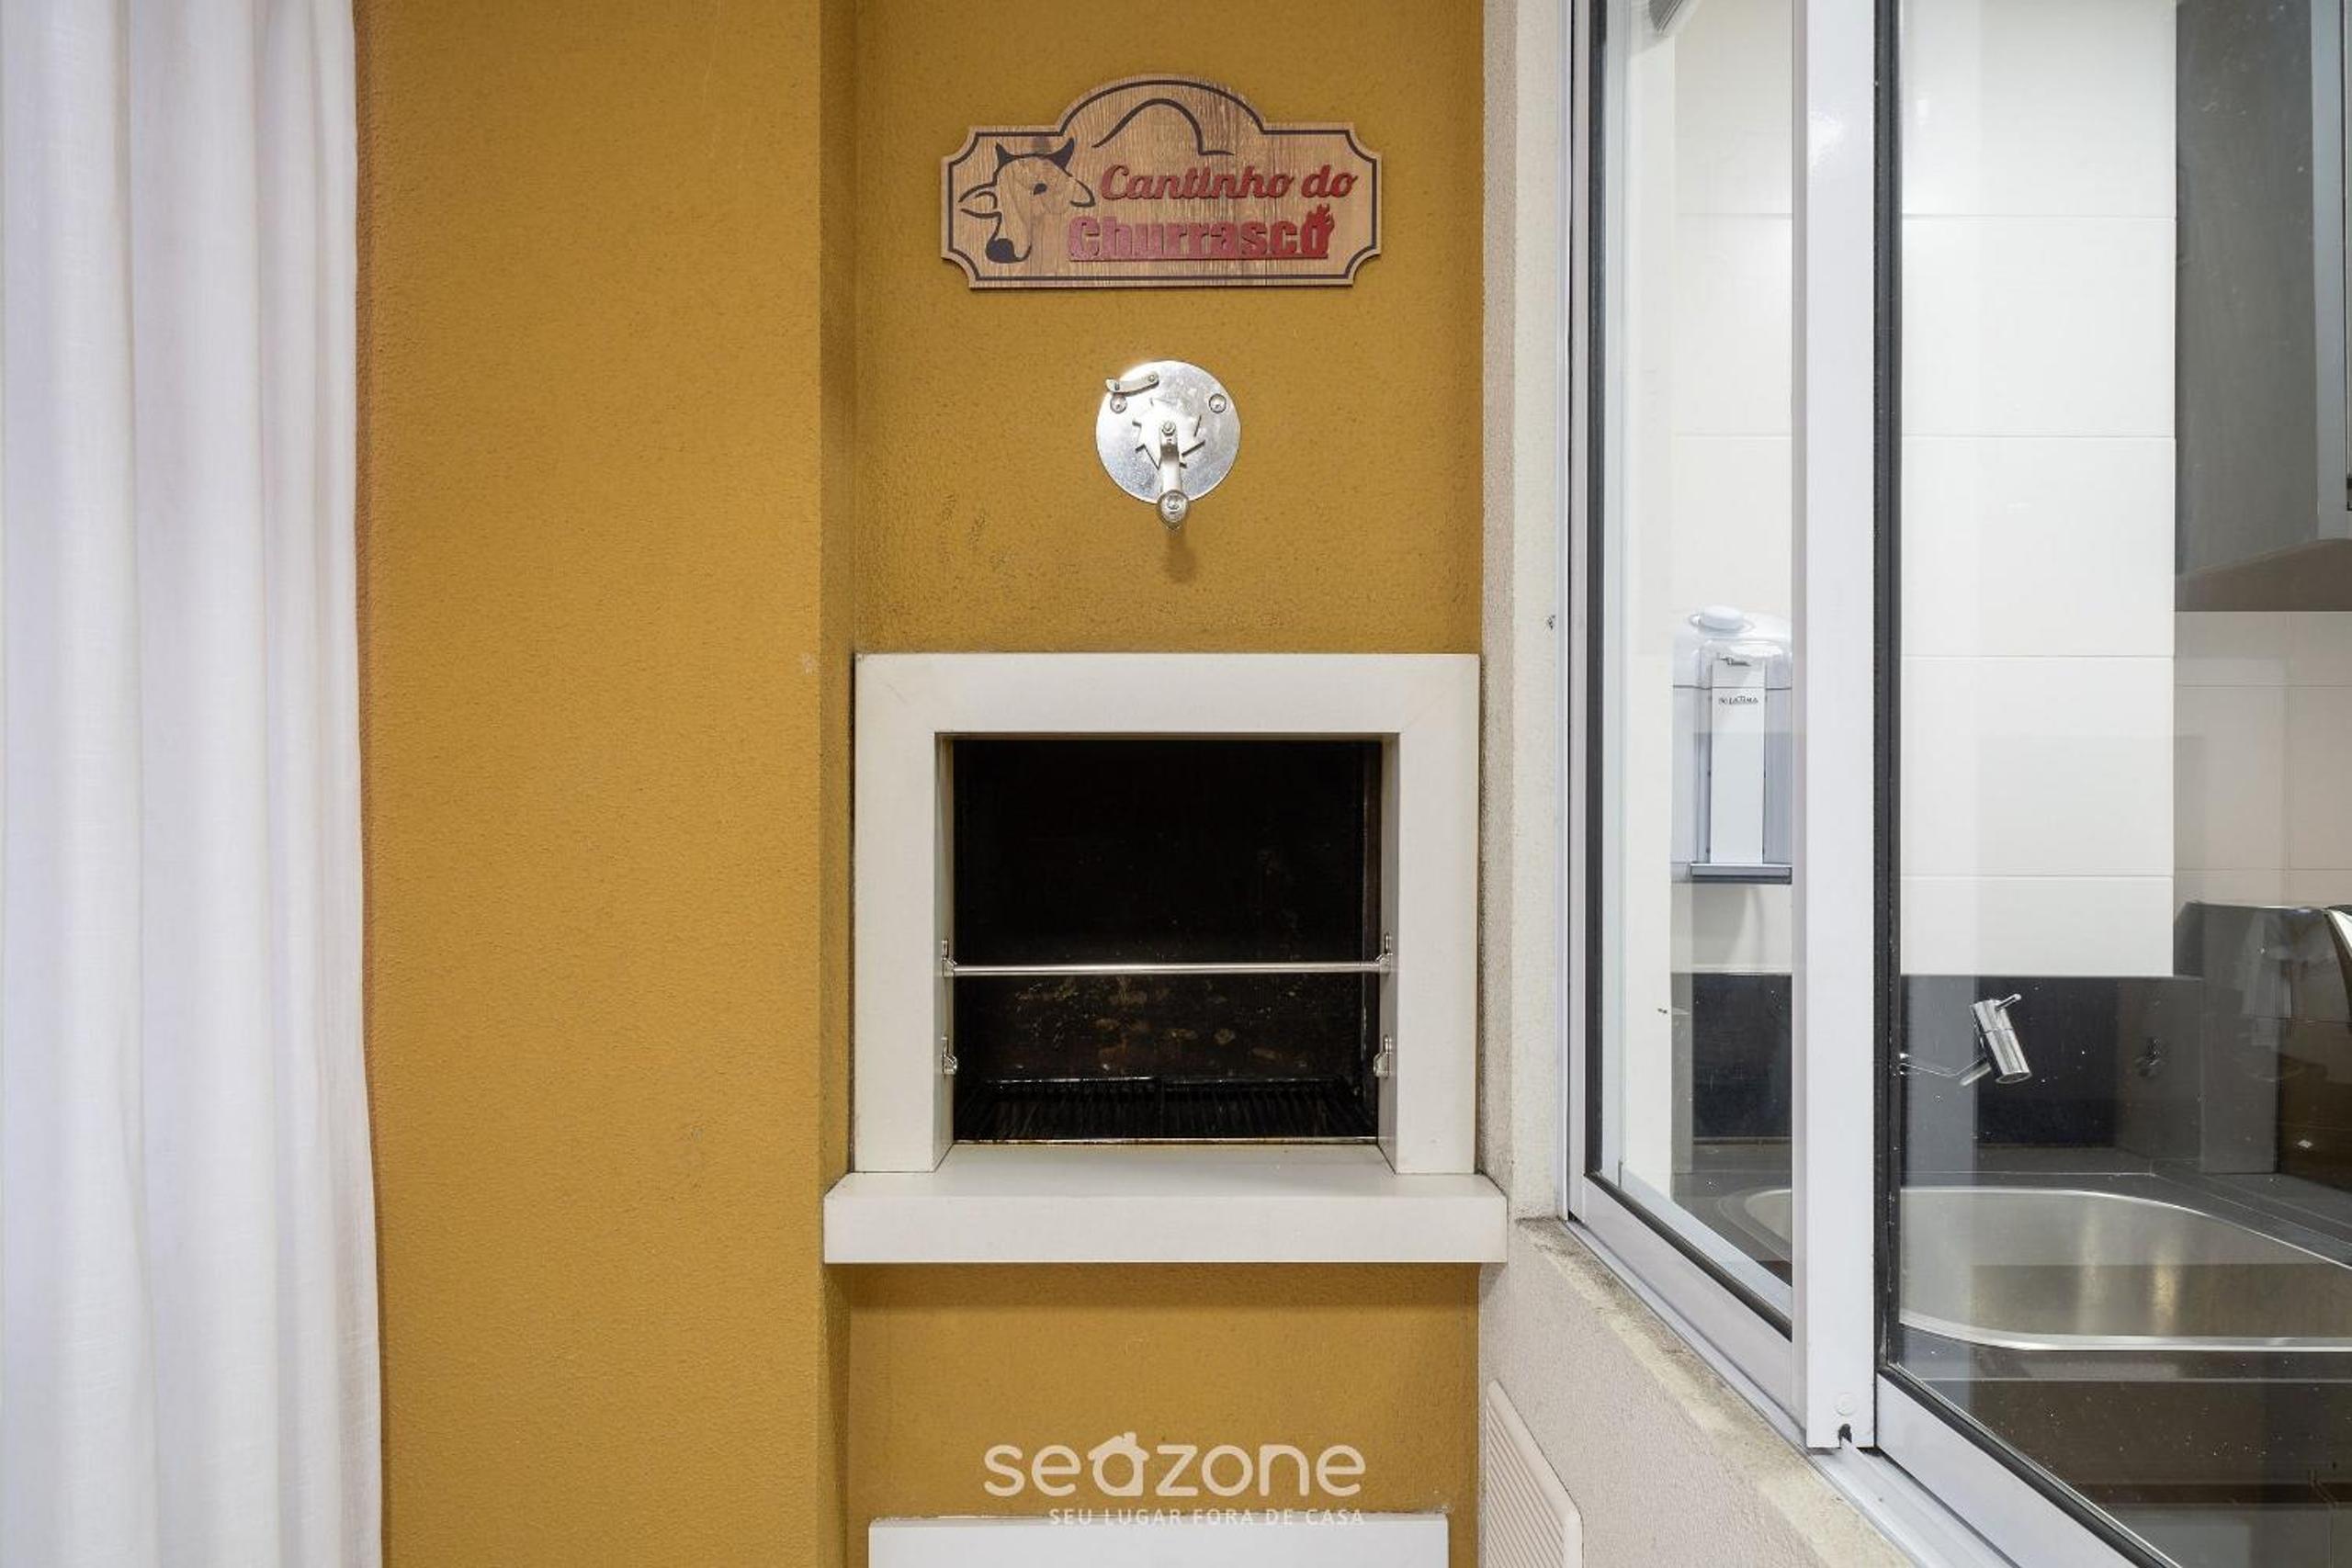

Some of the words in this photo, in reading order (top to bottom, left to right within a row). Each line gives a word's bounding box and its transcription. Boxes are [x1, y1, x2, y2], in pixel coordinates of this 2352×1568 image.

[1102, 164, 1295, 200] Cantinho
[1301, 164, 1358, 199] do
[1068, 207, 1335, 259] Churrasco
